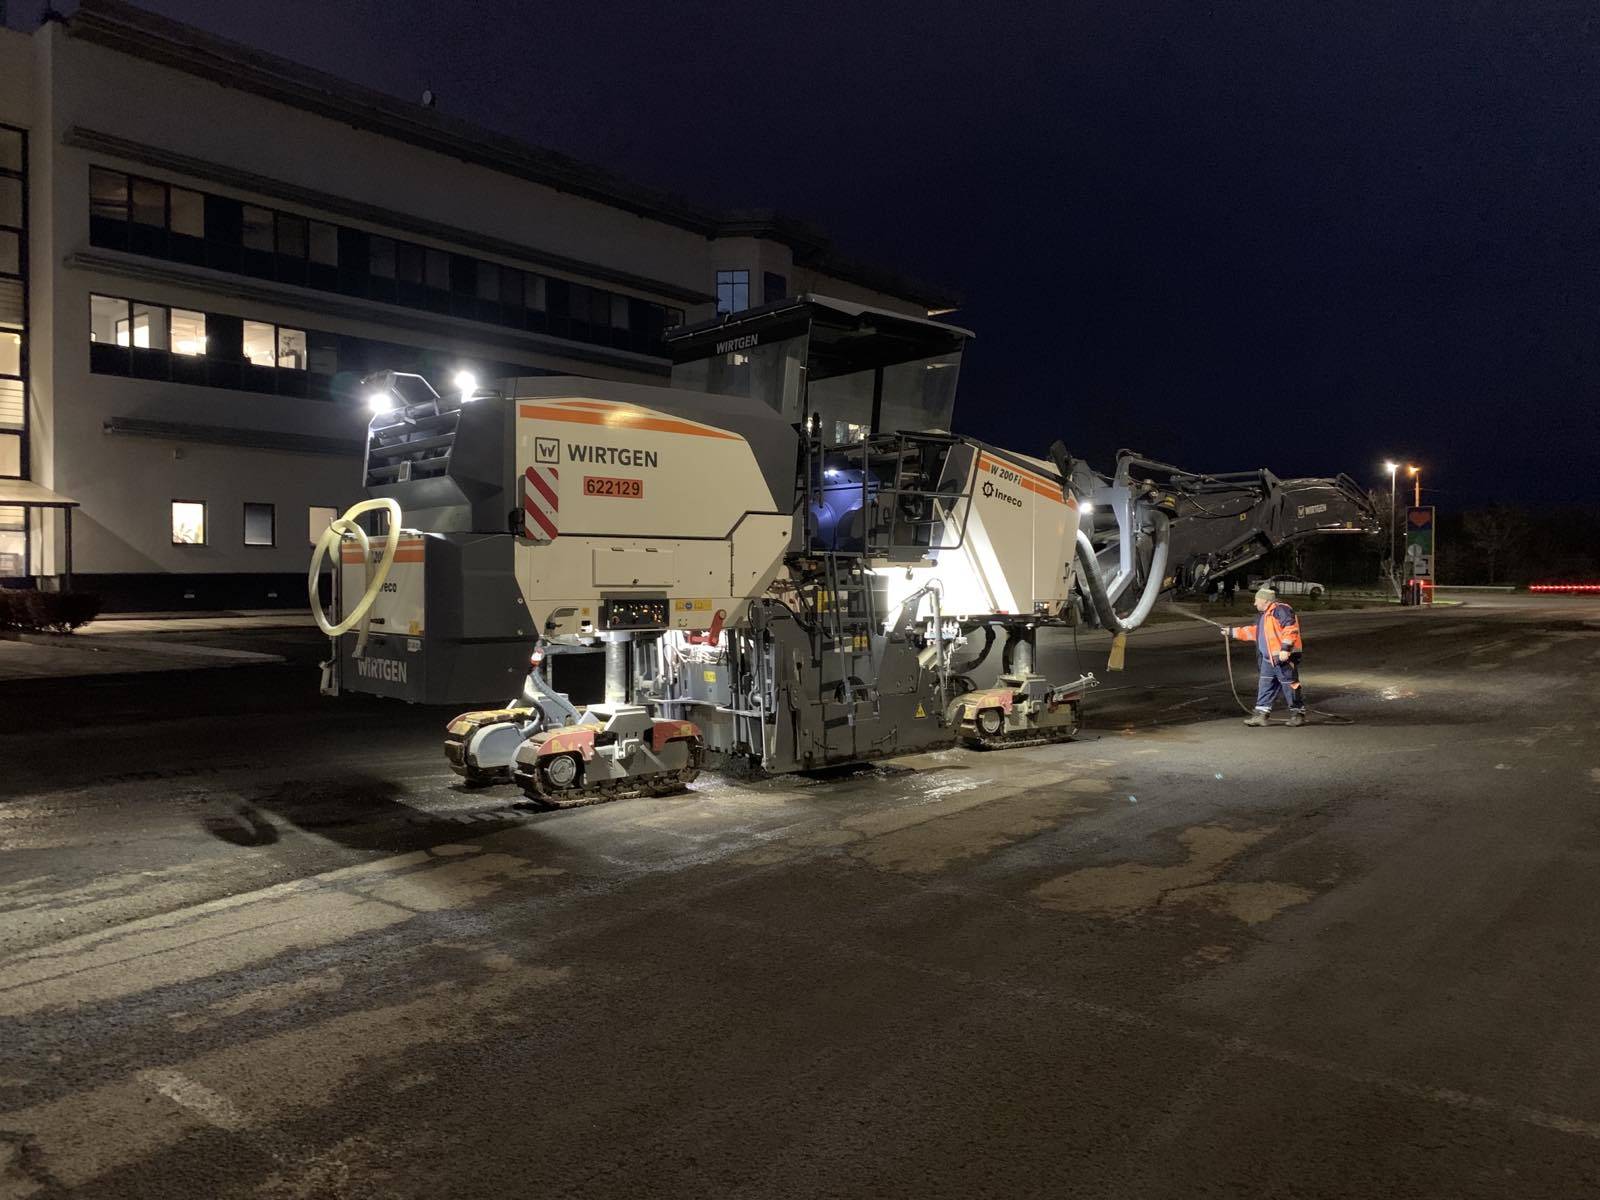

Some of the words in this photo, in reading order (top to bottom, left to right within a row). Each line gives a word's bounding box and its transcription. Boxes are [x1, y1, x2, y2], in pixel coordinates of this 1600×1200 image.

[716, 333, 758, 355] WIRTGEN
[567, 443, 658, 468] WIRTGEN
[991, 464, 999, 475] W
[999, 468, 1013, 481] 200
[586, 478, 640, 496] 622129
[995, 488, 1022, 507] Inreco
[357, 657, 407, 684] WIRTGEN
